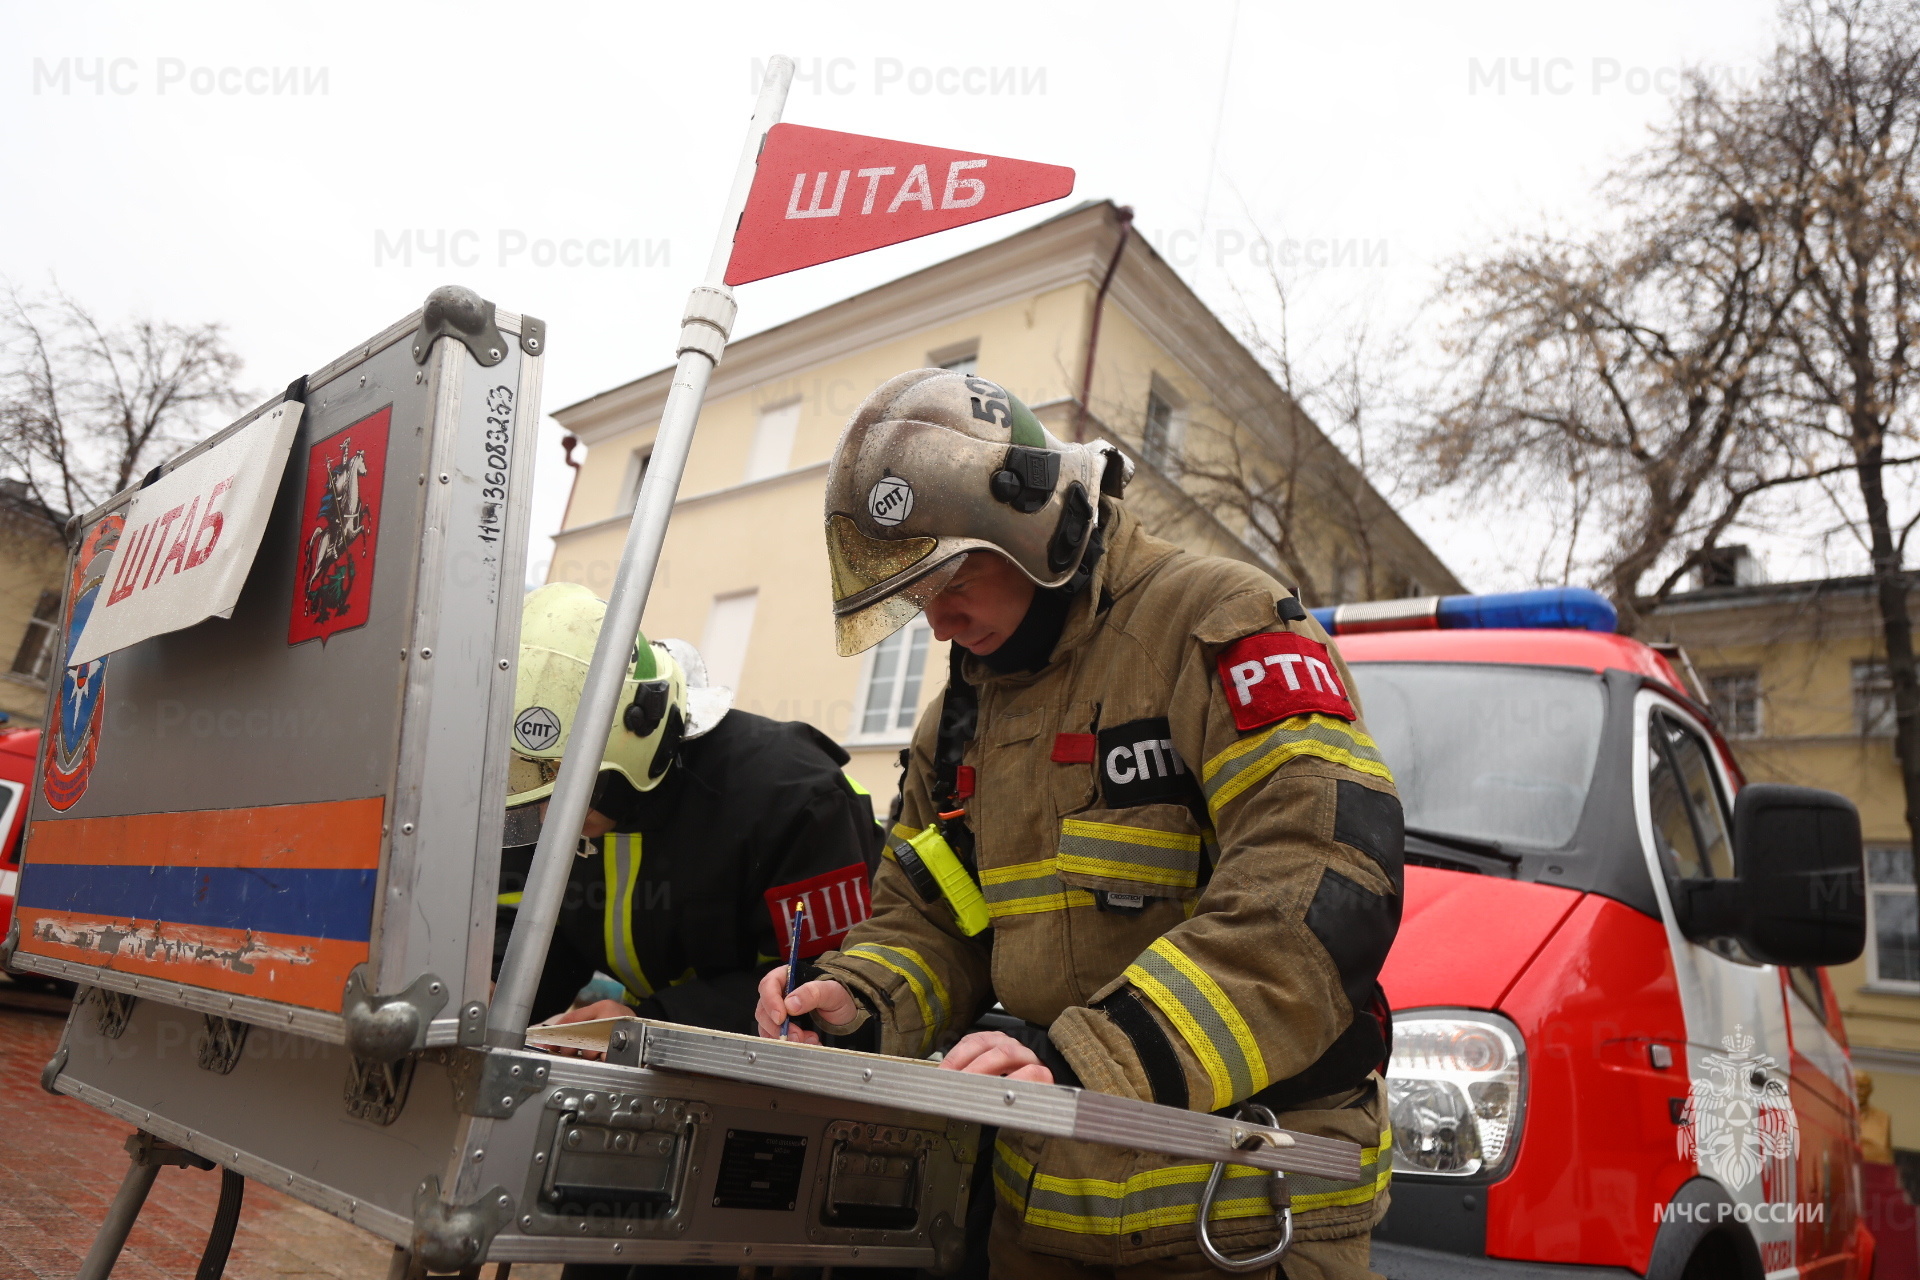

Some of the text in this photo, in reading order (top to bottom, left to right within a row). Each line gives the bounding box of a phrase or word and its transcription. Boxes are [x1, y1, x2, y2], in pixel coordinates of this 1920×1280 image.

[785, 159, 988, 219] ШТАБ
[875, 486, 904, 516] СПТ
[105, 473, 236, 608] ШТАБ
[1229, 653, 1341, 707] РТП
[521, 721, 553, 738] СПТ
[1106, 739, 1185, 785] СПТ
[775, 876, 868, 948] НШ
